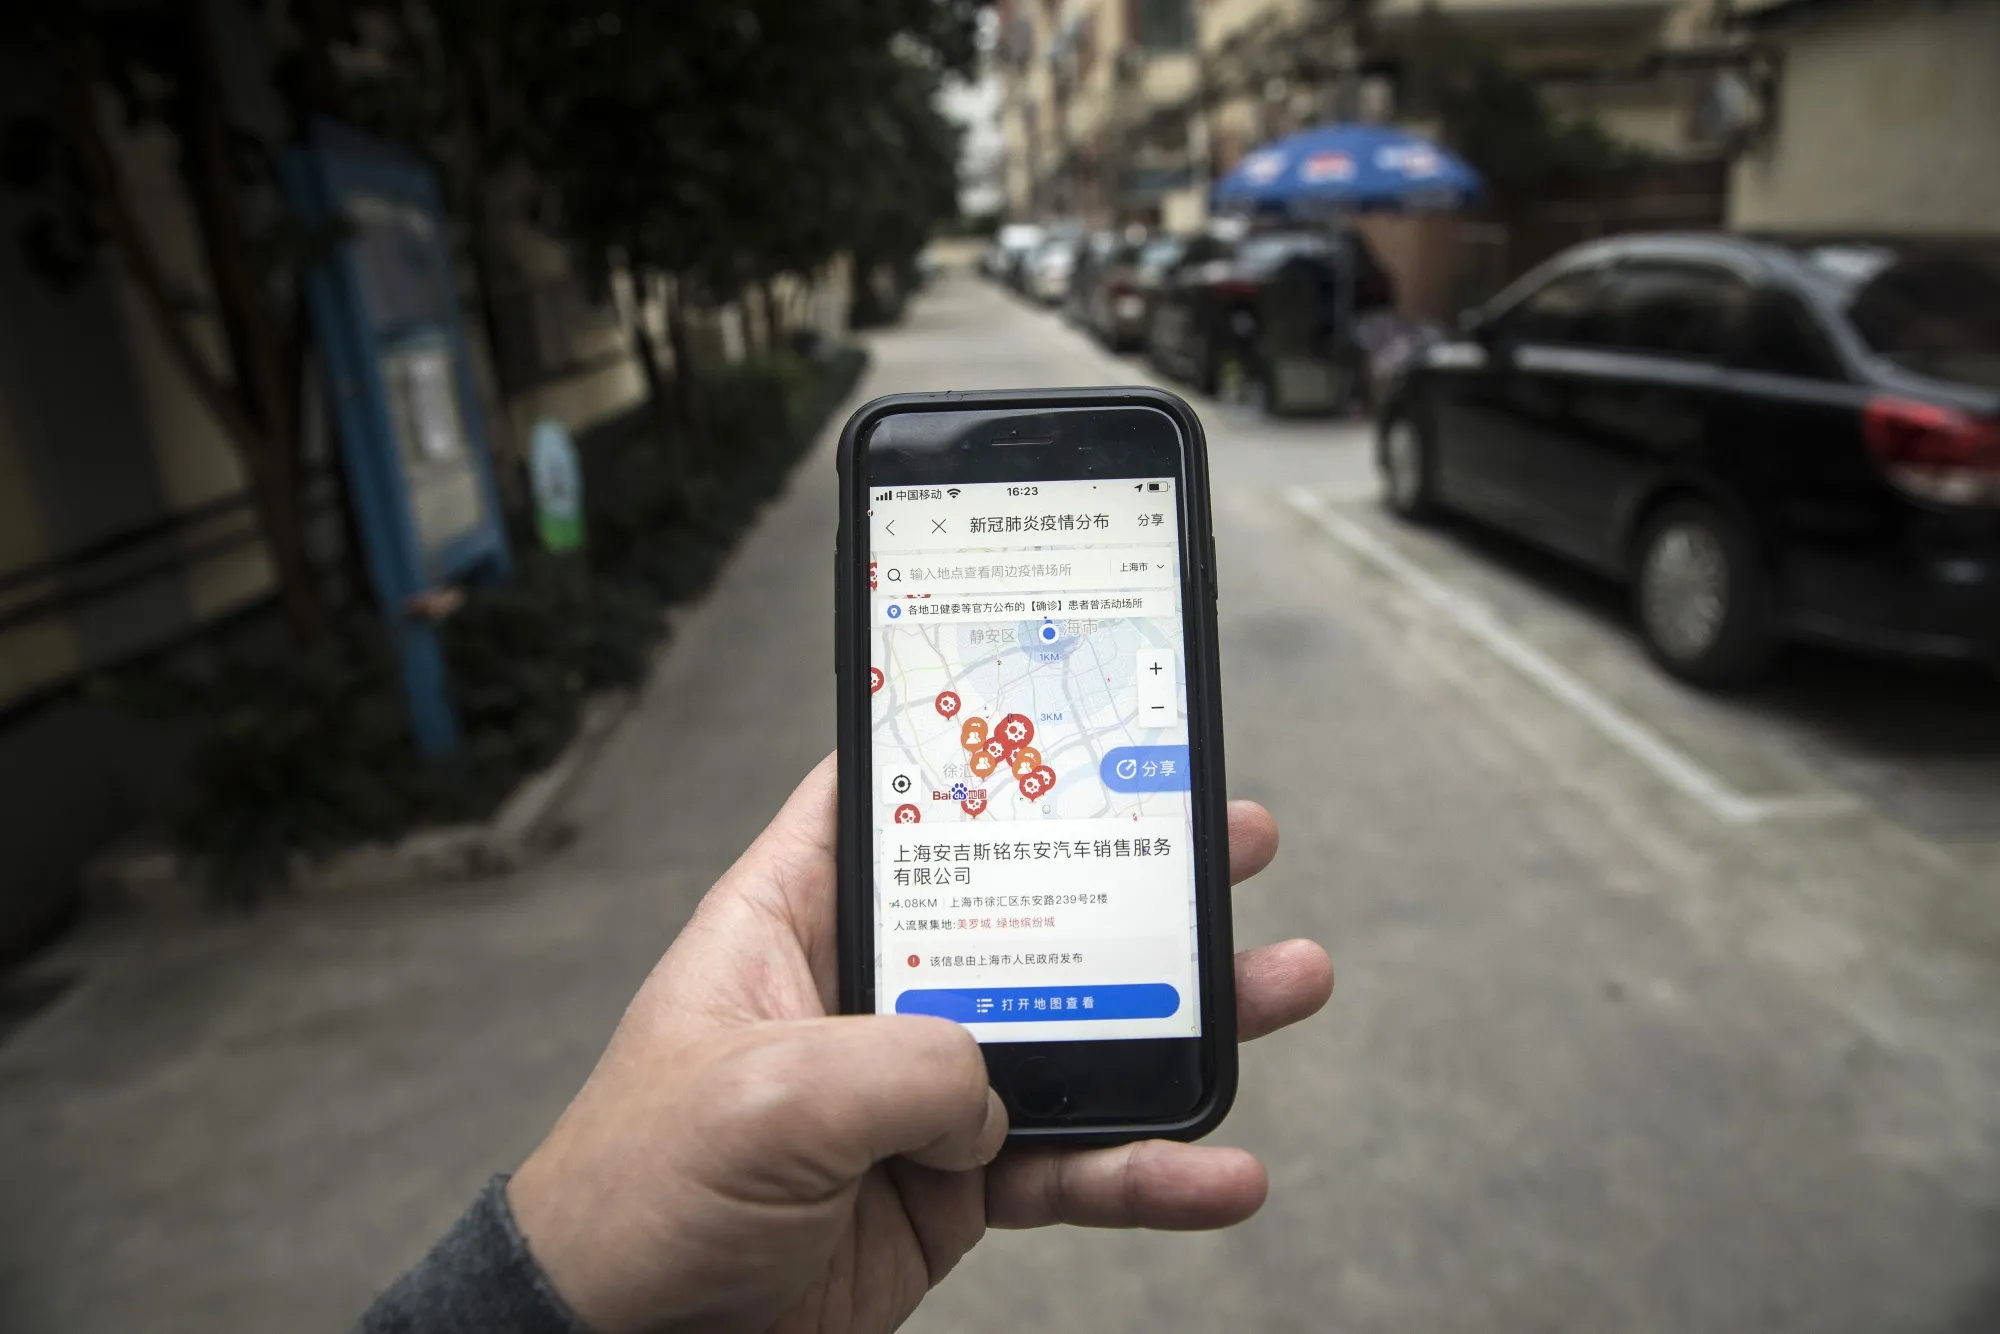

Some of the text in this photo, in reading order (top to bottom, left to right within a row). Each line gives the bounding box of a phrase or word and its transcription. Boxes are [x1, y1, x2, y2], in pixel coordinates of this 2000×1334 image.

[896, 489, 942, 501] 中国移动
[1007, 486, 1039, 497] 16:23
[969, 513, 1110, 534] 新冠肺炎疫情分布
[1137, 513, 1165, 527] 分享
[909, 563, 1072, 581] 输入地点查看周边疫情场所
[1120, 561, 1148, 573] 上海市
[908, 598, 1143, 616] 各地卫健委等官方公布的【确诊】患者曾活动场所
[1056, 618, 1098, 636] 海市
[970, 628, 1015, 645] 静安区
[1039, 653, 1060, 662] 1KM
[1040, 712, 1063, 722] 3KM
[1142, 761, 1177, 777] 分享
[893, 838, 1172, 863] 上海安吉斯铭东安汽车销售服务
[894, 867, 971, 886] 有限公司
[949, 893, 1108, 908] 上海市徐汇区东安路239号2楼
[929, 952, 1083, 967] 该信息由上海市人民政府发布
[1001, 996, 1095, 1011] 打开地图查看
